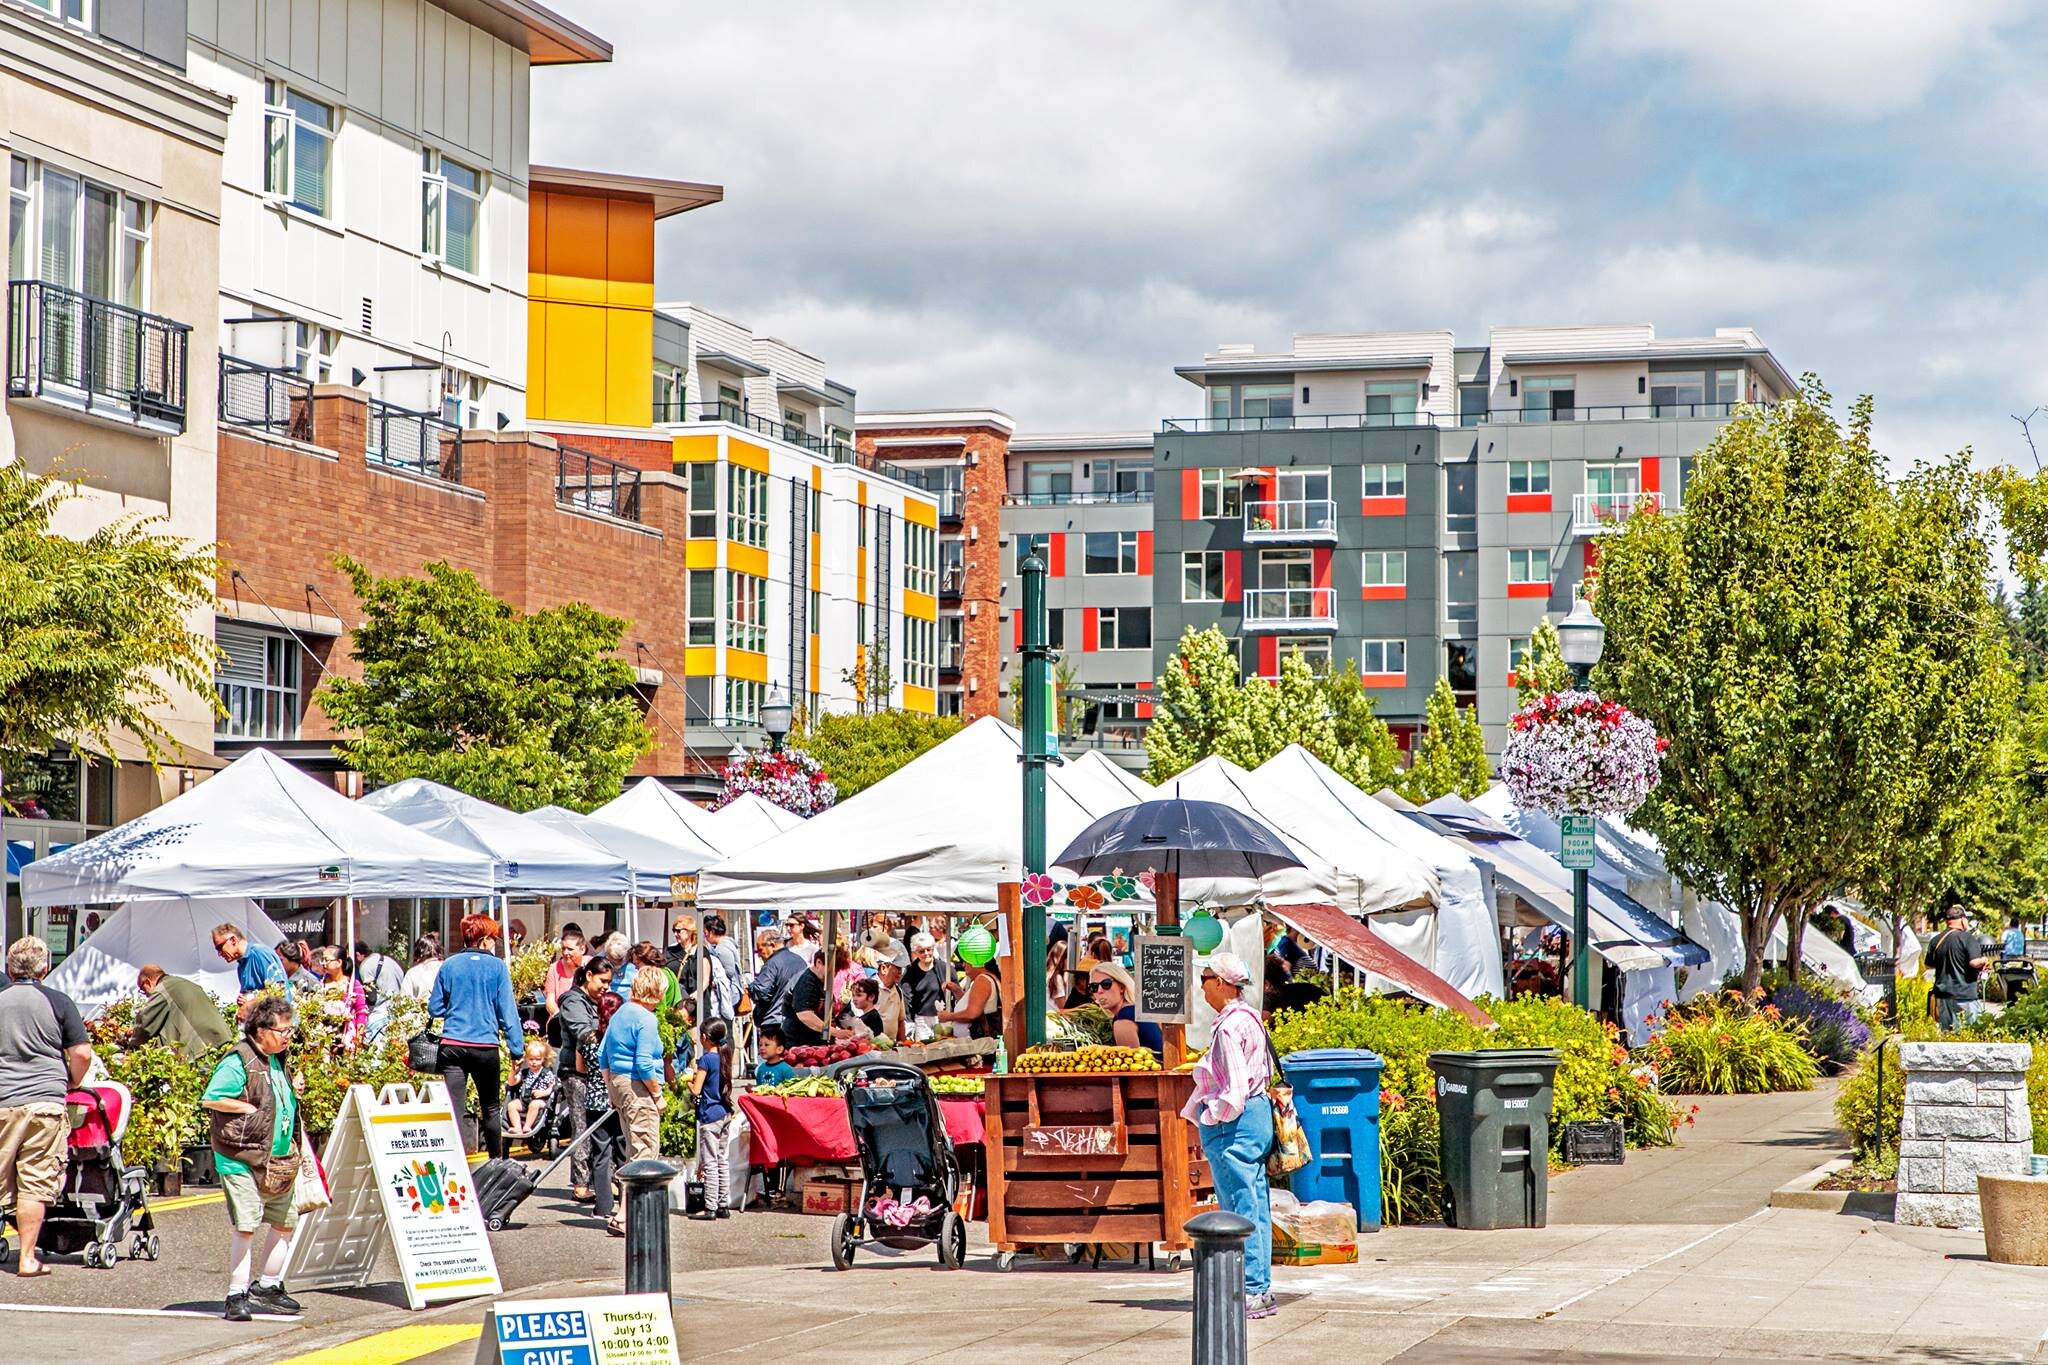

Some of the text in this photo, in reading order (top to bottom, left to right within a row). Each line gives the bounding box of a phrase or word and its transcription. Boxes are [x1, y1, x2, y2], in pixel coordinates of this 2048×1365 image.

[1563, 819, 1571, 833] 2
[298, 920, 303, 932] &
[304, 919, 326, 932] Nuts!
[1144, 944, 1165, 956] Fresh
[1144, 955, 1152, 965] Is
[1153, 955, 1168, 967] Fast
[1143, 965, 1158, 977] Free
[1144, 977, 1158, 988] For
[1148, 997, 1177, 1010] Burien
[1446, 1082, 1468, 1095] GARBAGE
[401, 1128, 428, 1139] WHAT DO
[390, 1138, 445, 1149] FRESH BUCKS BUY?
[603, 1311, 657, 1323] Thursday,
[501, 1312, 585, 1339] PLEASE
[614, 1323, 652, 1337] July 13
[601, 1335, 669, 1350] 10:00 to 4:00
[523, 1349, 574, 1365] GIVE
